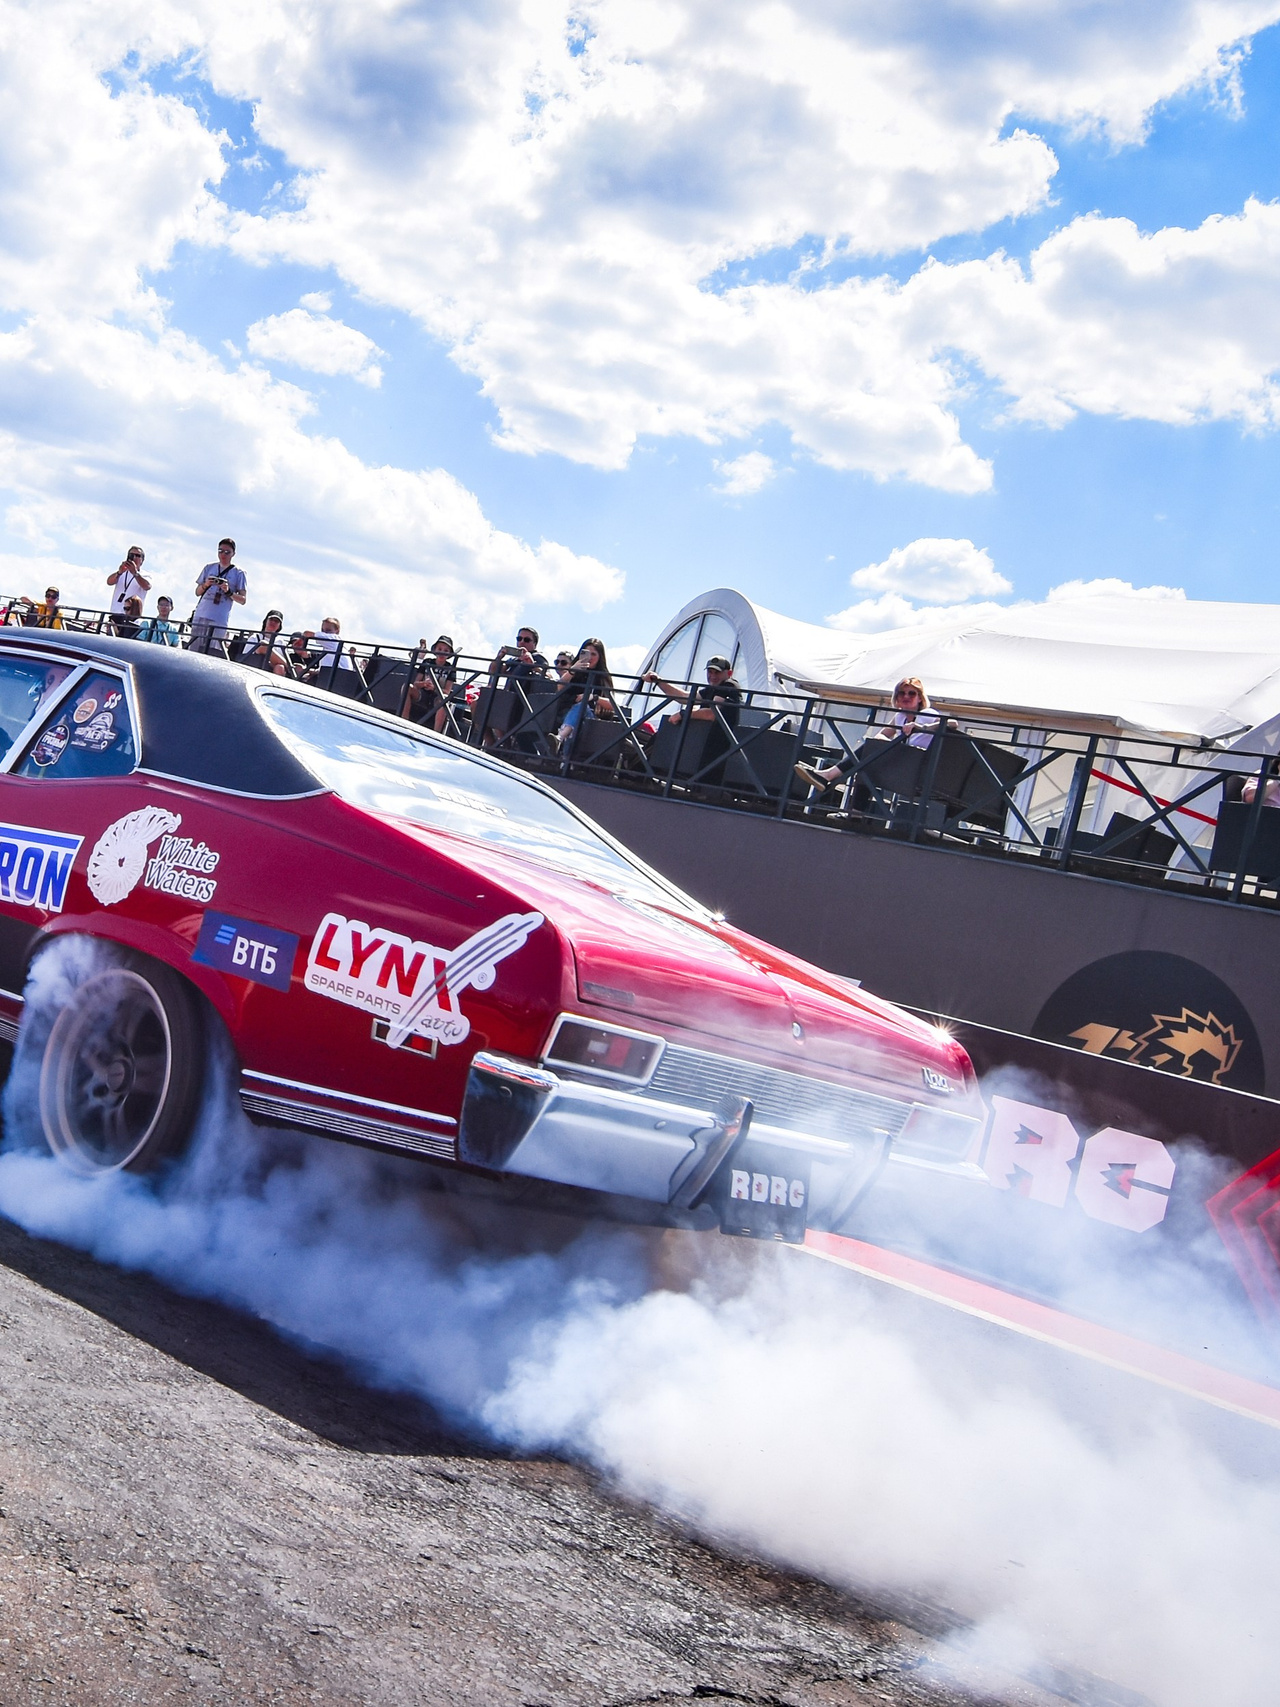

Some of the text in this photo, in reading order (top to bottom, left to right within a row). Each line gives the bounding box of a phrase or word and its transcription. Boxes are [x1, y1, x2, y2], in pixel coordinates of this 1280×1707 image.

[158, 836, 218, 871] White
[145, 860, 216, 900] Waters
[232, 935, 279, 975] ВТБ
[314, 918, 495, 1014] LYNX
[310, 973, 402, 1015] SPARE PARTS
[971, 1094, 1176, 1233] RC
[730, 1169, 805, 1209] RDRC
